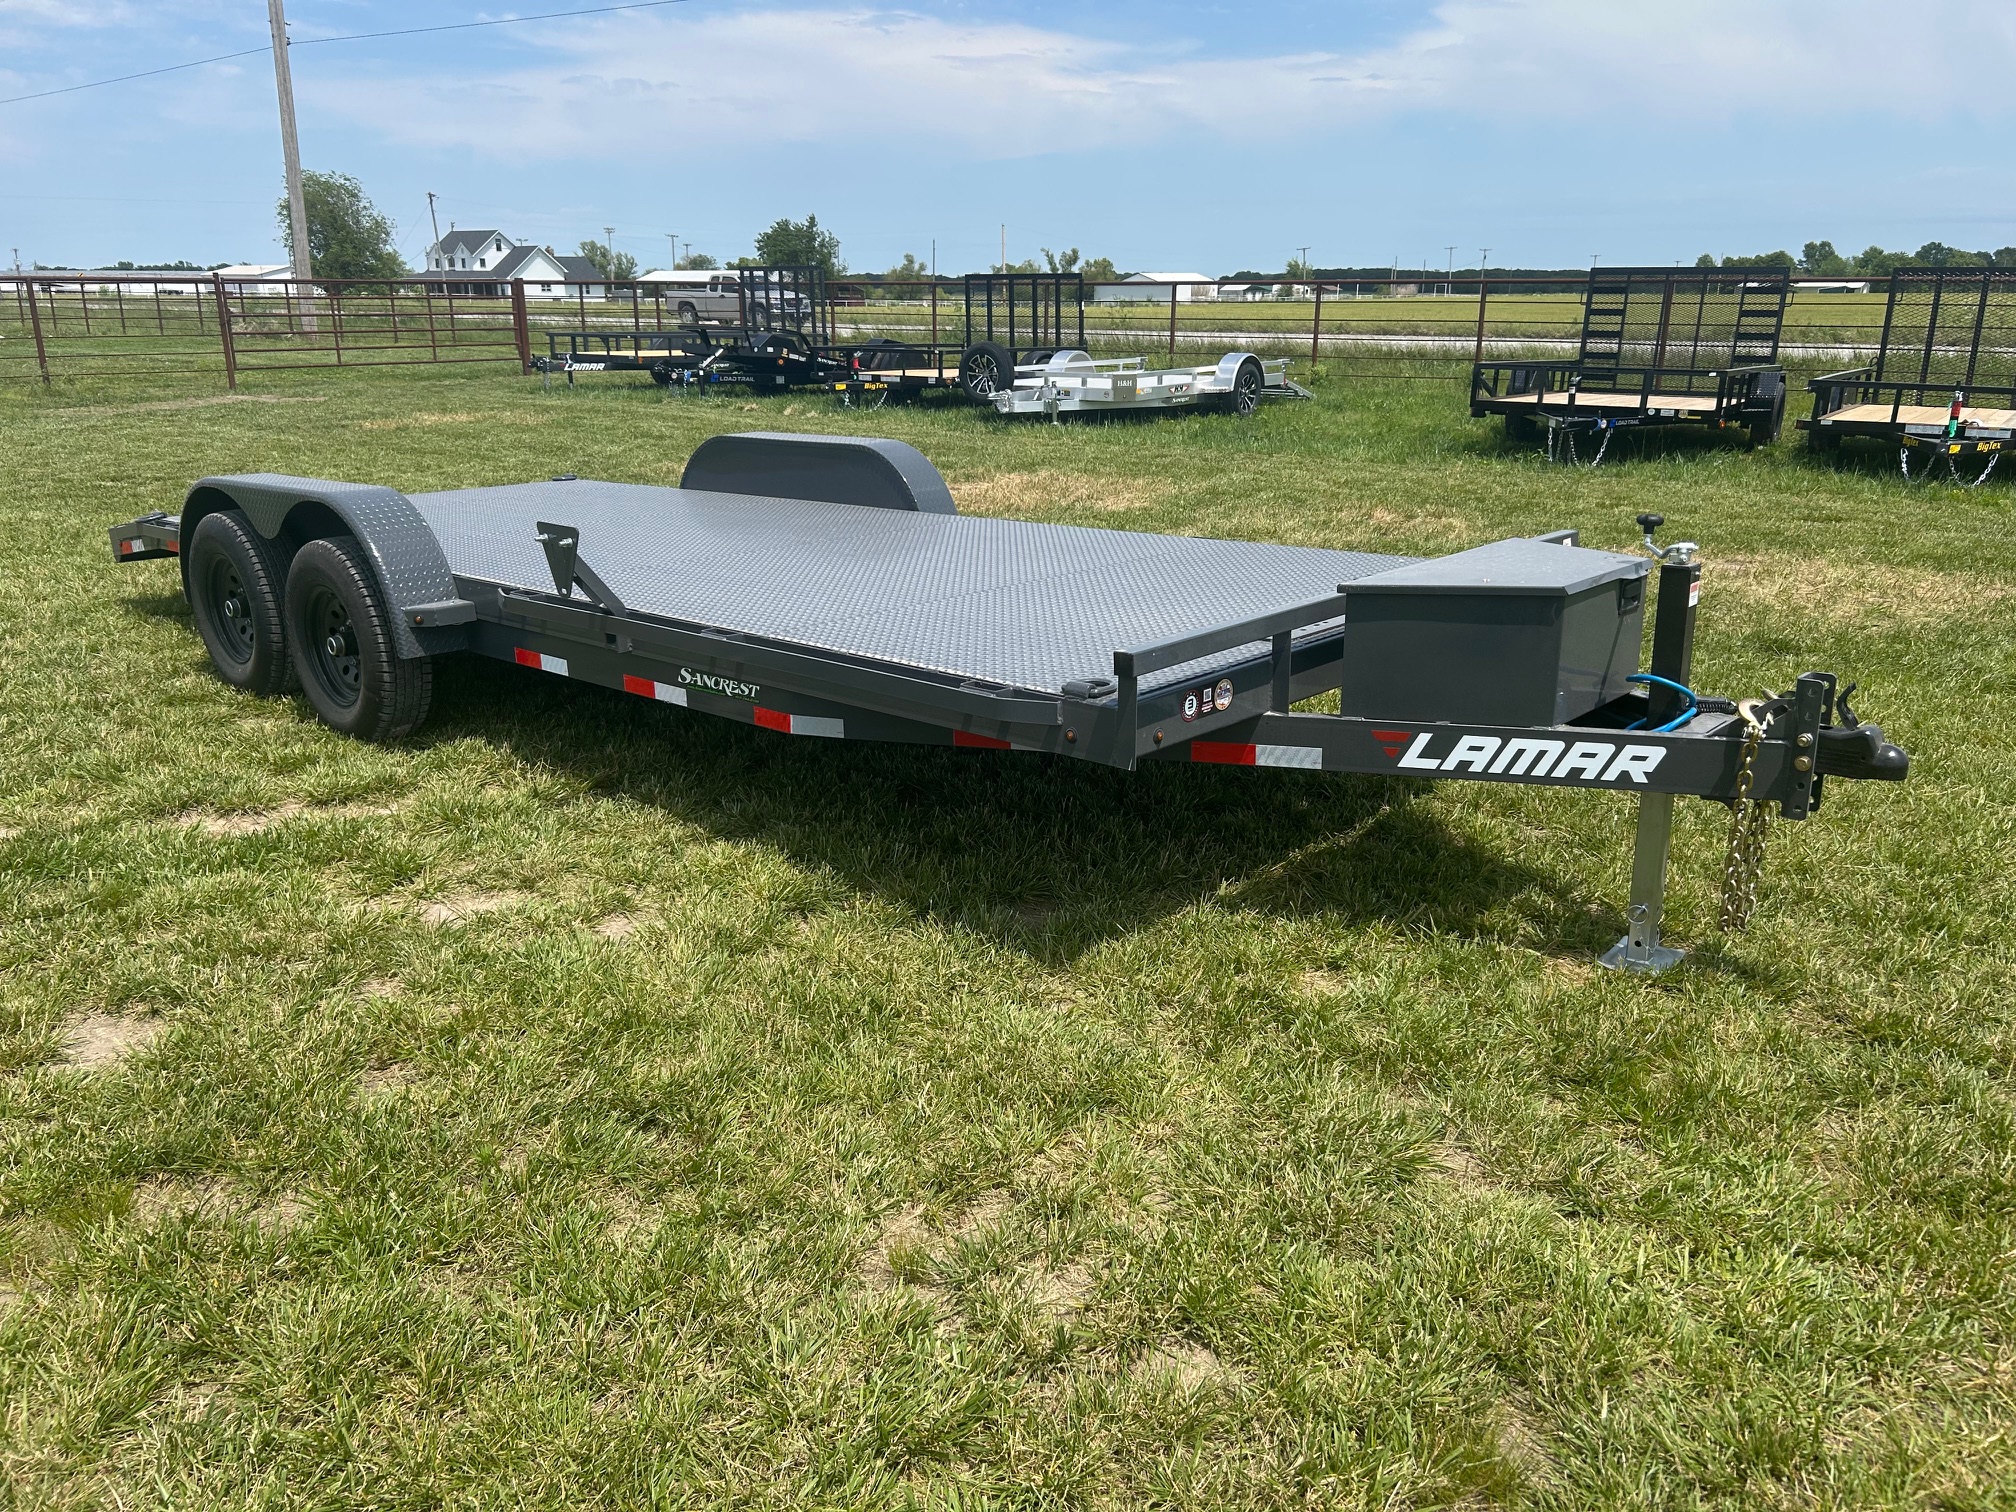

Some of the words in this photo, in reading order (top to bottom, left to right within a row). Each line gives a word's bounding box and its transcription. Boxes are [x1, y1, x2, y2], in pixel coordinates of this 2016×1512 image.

[564, 362, 606, 371] LAMAR
[864, 382, 888, 391] BigTex
[1976, 441, 2003, 453] BigTex
[1397, 732, 1667, 783] LAMAR
